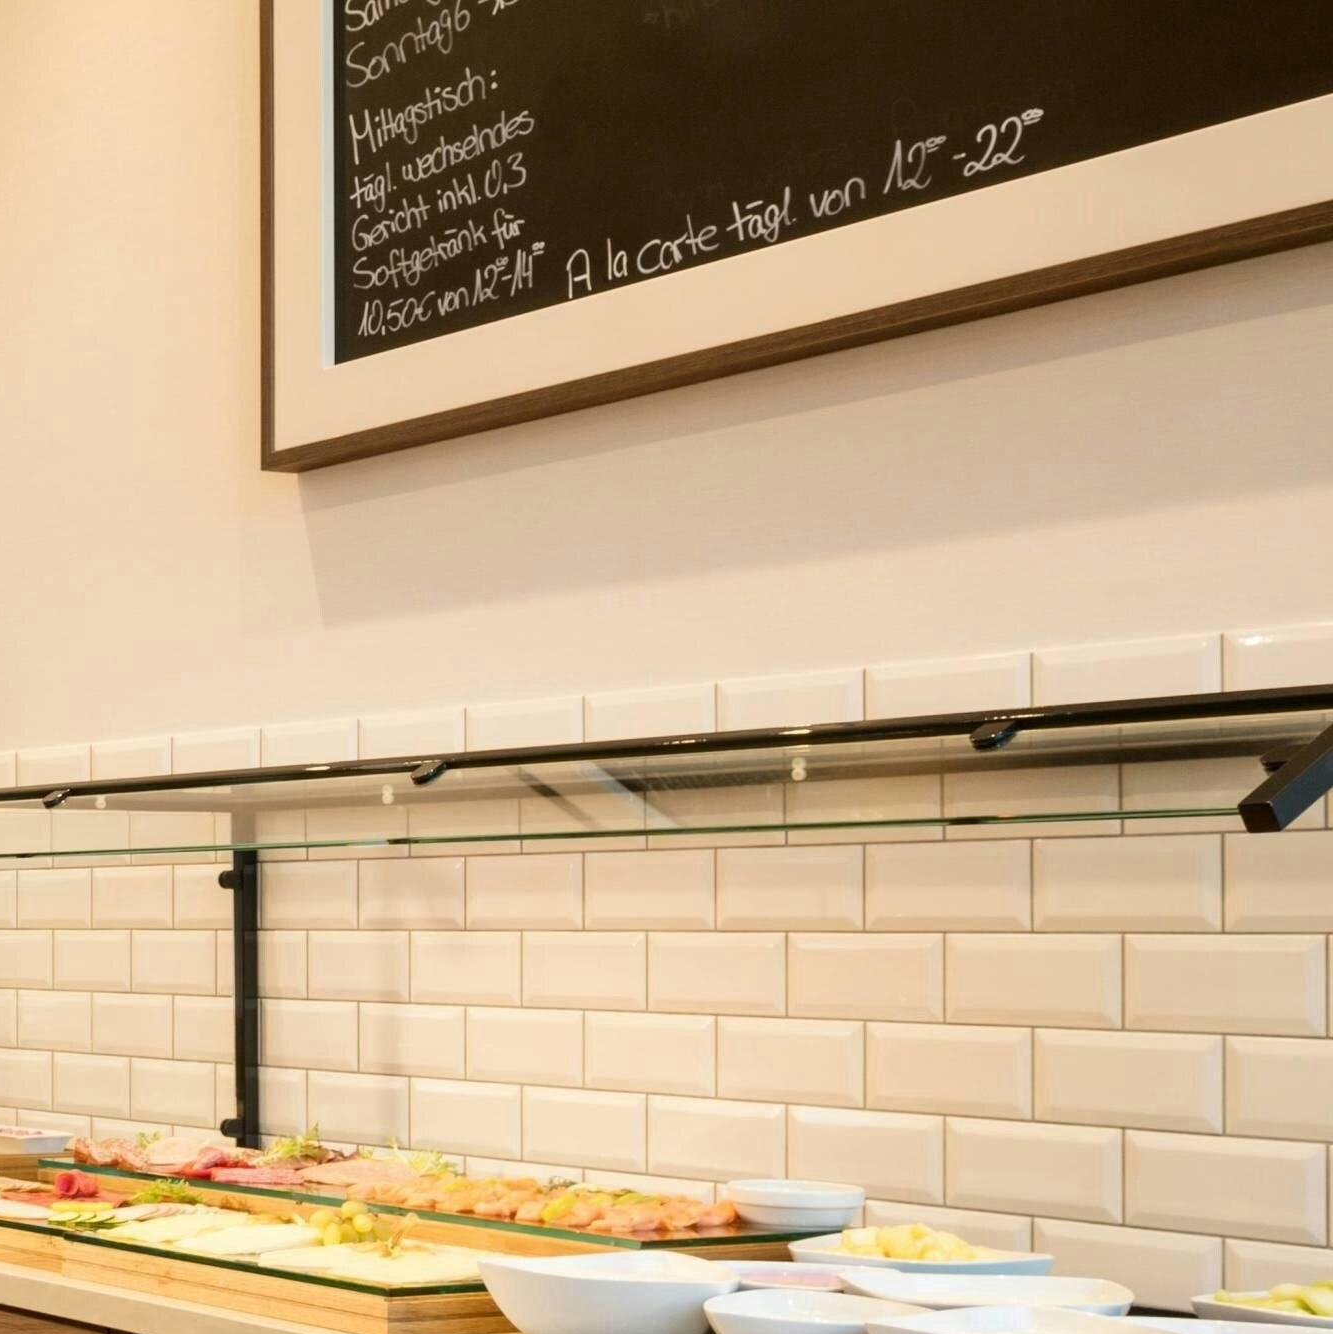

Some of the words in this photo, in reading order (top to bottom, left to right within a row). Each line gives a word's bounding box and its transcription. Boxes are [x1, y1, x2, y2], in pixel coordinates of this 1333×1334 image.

[349, 66, 498, 165] Mittagstisch:
[402, 110, 534, 182] wechselndes
[352, 194, 431, 252] Gericht
[437, 173, 482, 213] inkl.
[353, 219, 487, 289] Softgetränk
[491, 208, 525, 250] für
[565, 248, 592, 300] A
[606, 238, 629, 281] la
[809, 177, 867, 219] von
